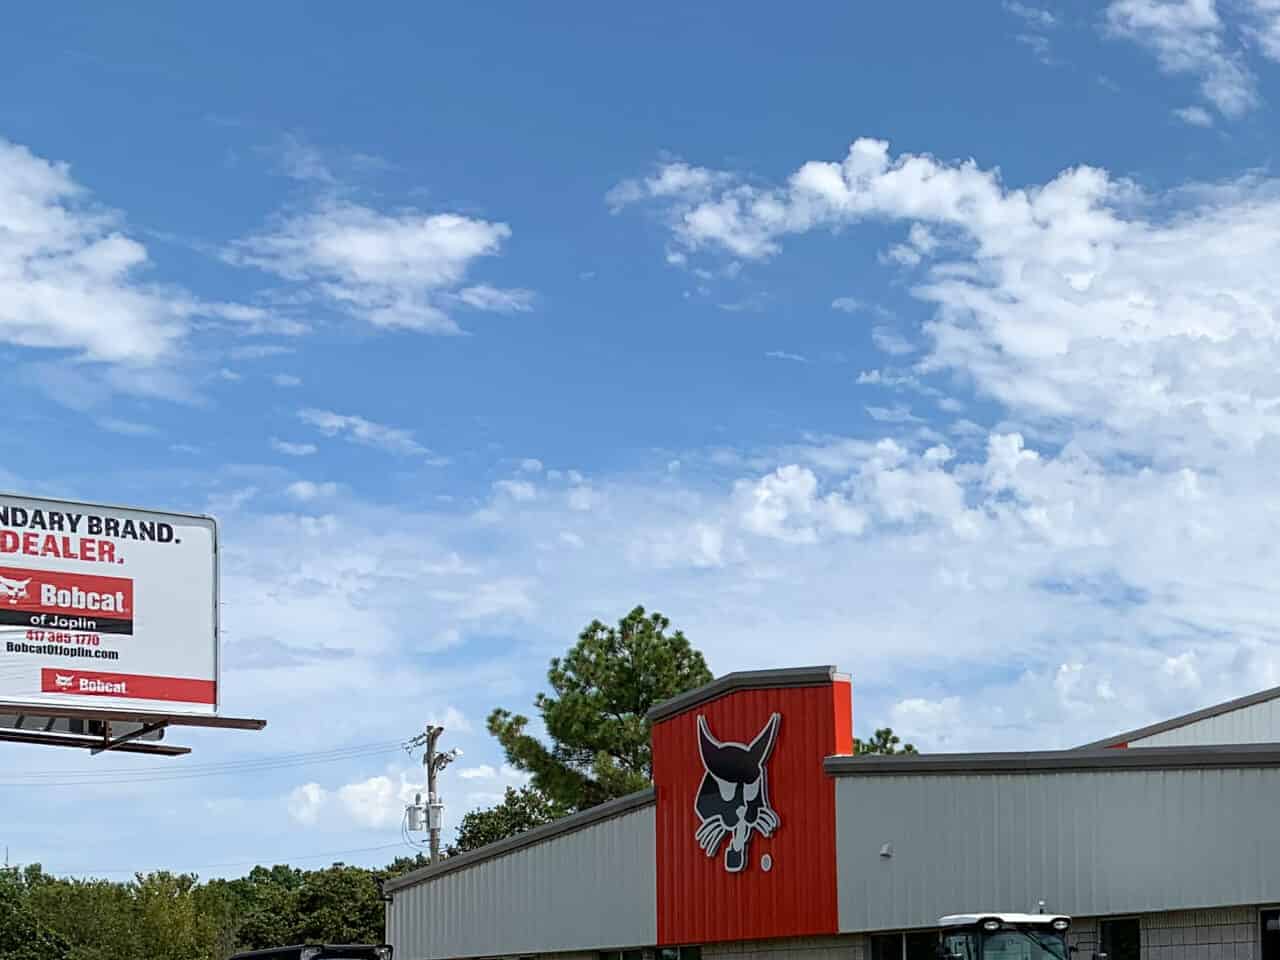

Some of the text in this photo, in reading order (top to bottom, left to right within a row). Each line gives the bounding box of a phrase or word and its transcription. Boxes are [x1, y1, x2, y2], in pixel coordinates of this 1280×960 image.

[87, 515, 181, 544] BRAND.
[0, 530, 124, 565] DEALER.
[40, 583, 125, 613] Bobcat
[30, 614, 97, 630] of Joplin
[25, 629, 45, 641] 417
[6, 641, 119, 660] BobcatOfJoplin.com
[79, 678, 126, 694] Bobcat
